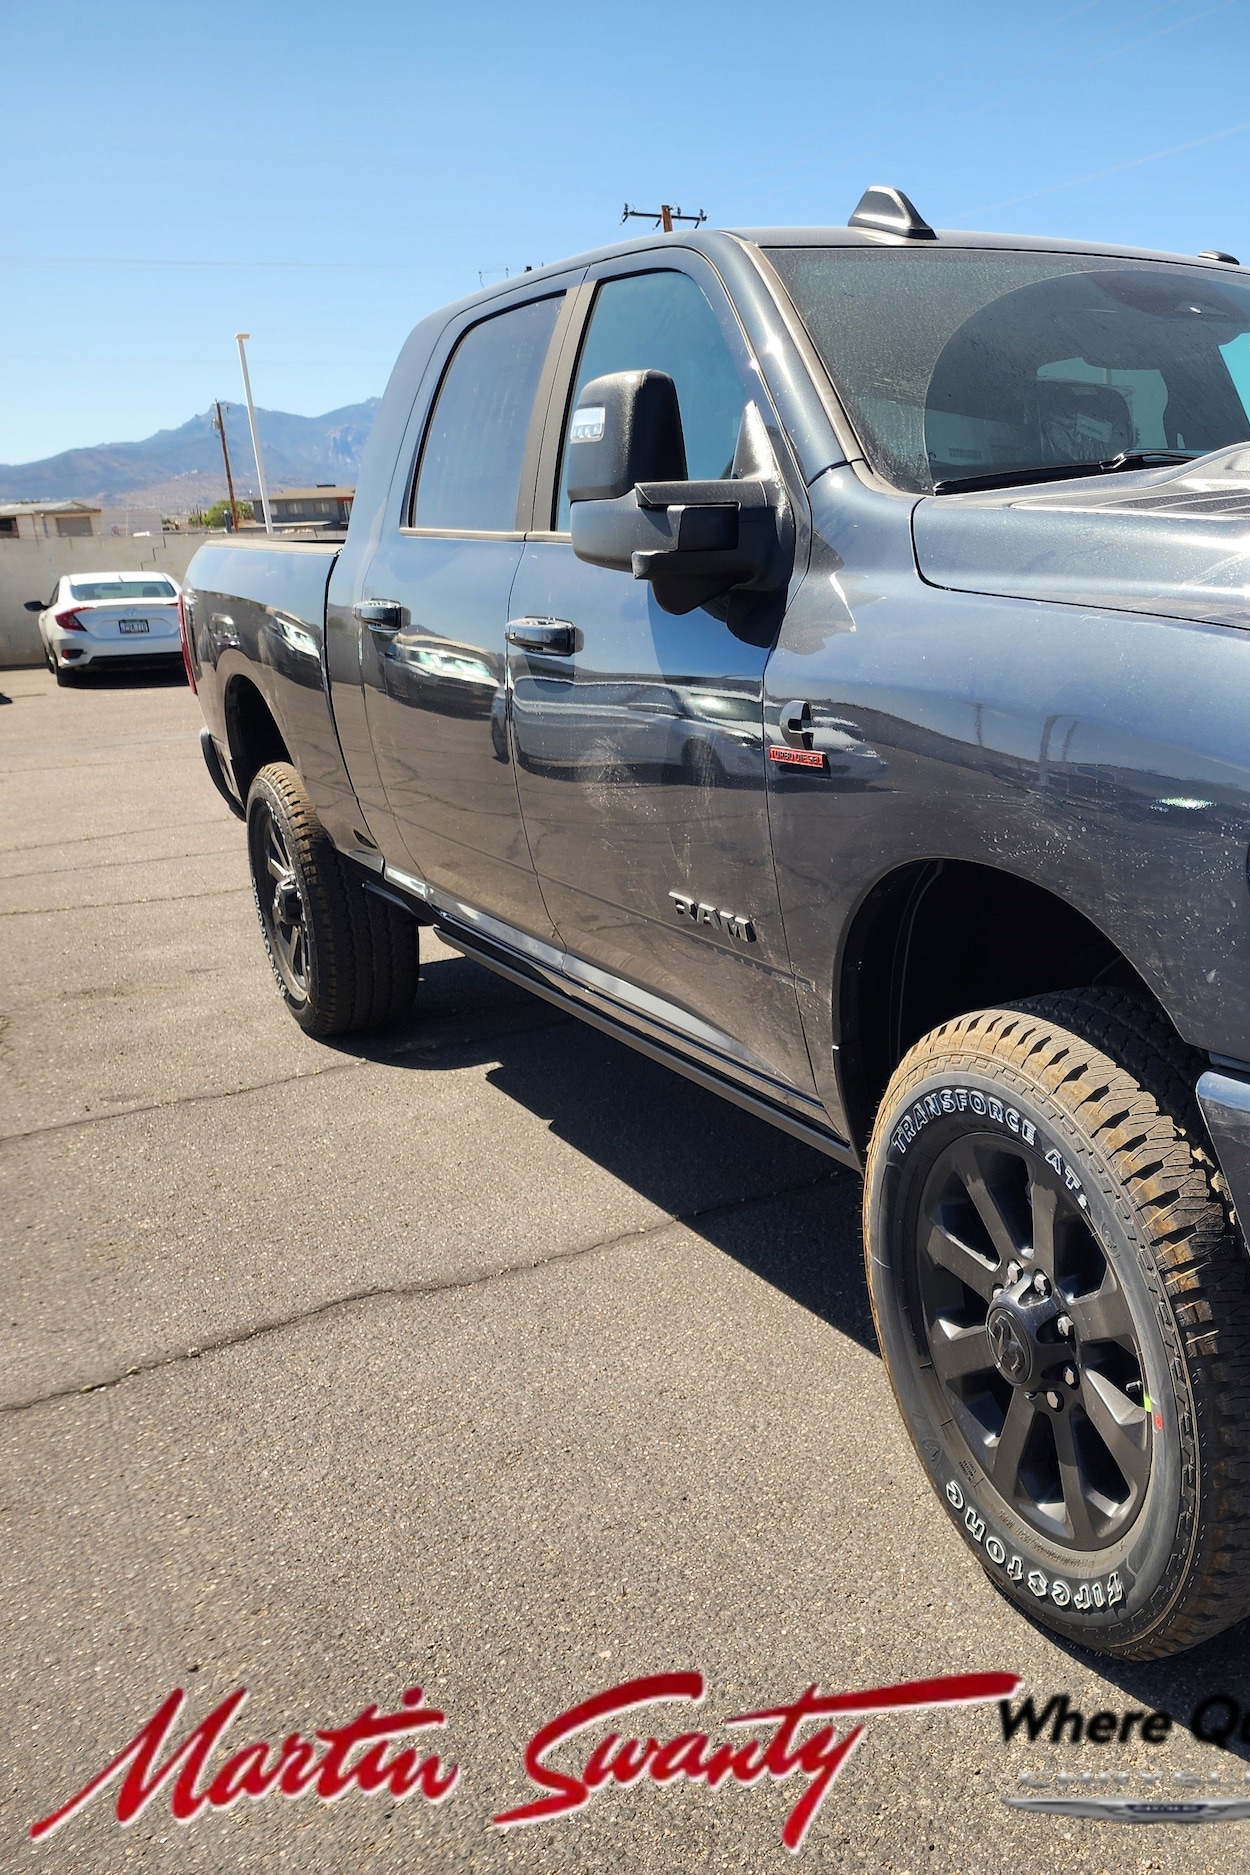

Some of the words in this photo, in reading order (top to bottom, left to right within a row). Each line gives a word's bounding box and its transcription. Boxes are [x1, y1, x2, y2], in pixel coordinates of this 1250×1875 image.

[770, 749, 795, 762] TURBO
[796, 753, 823, 766] DIESEL
[668, 891, 757, 943] RAM
[891, 1088, 1037, 1154] TRANSFORCE
[946, 1479, 1124, 1610] Firestone
